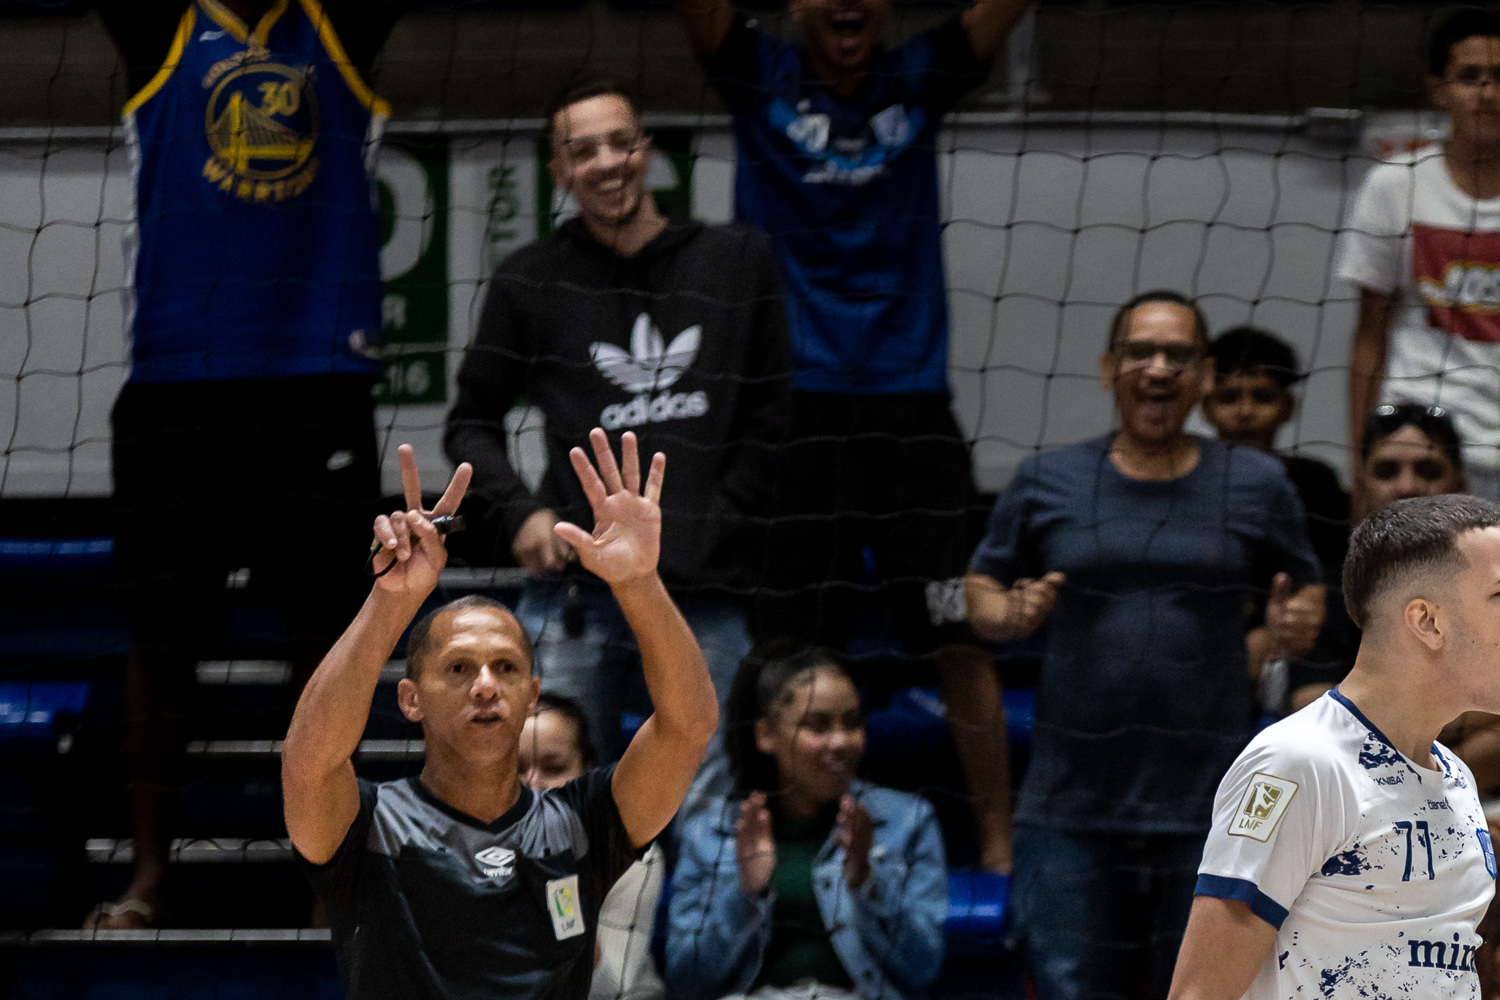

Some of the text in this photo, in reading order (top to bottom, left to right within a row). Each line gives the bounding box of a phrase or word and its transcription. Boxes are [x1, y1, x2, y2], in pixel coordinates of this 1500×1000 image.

[257, 81, 300, 116] 30
[600, 390, 711, 430] adidas
[1239, 818, 1263, 830] LNF
